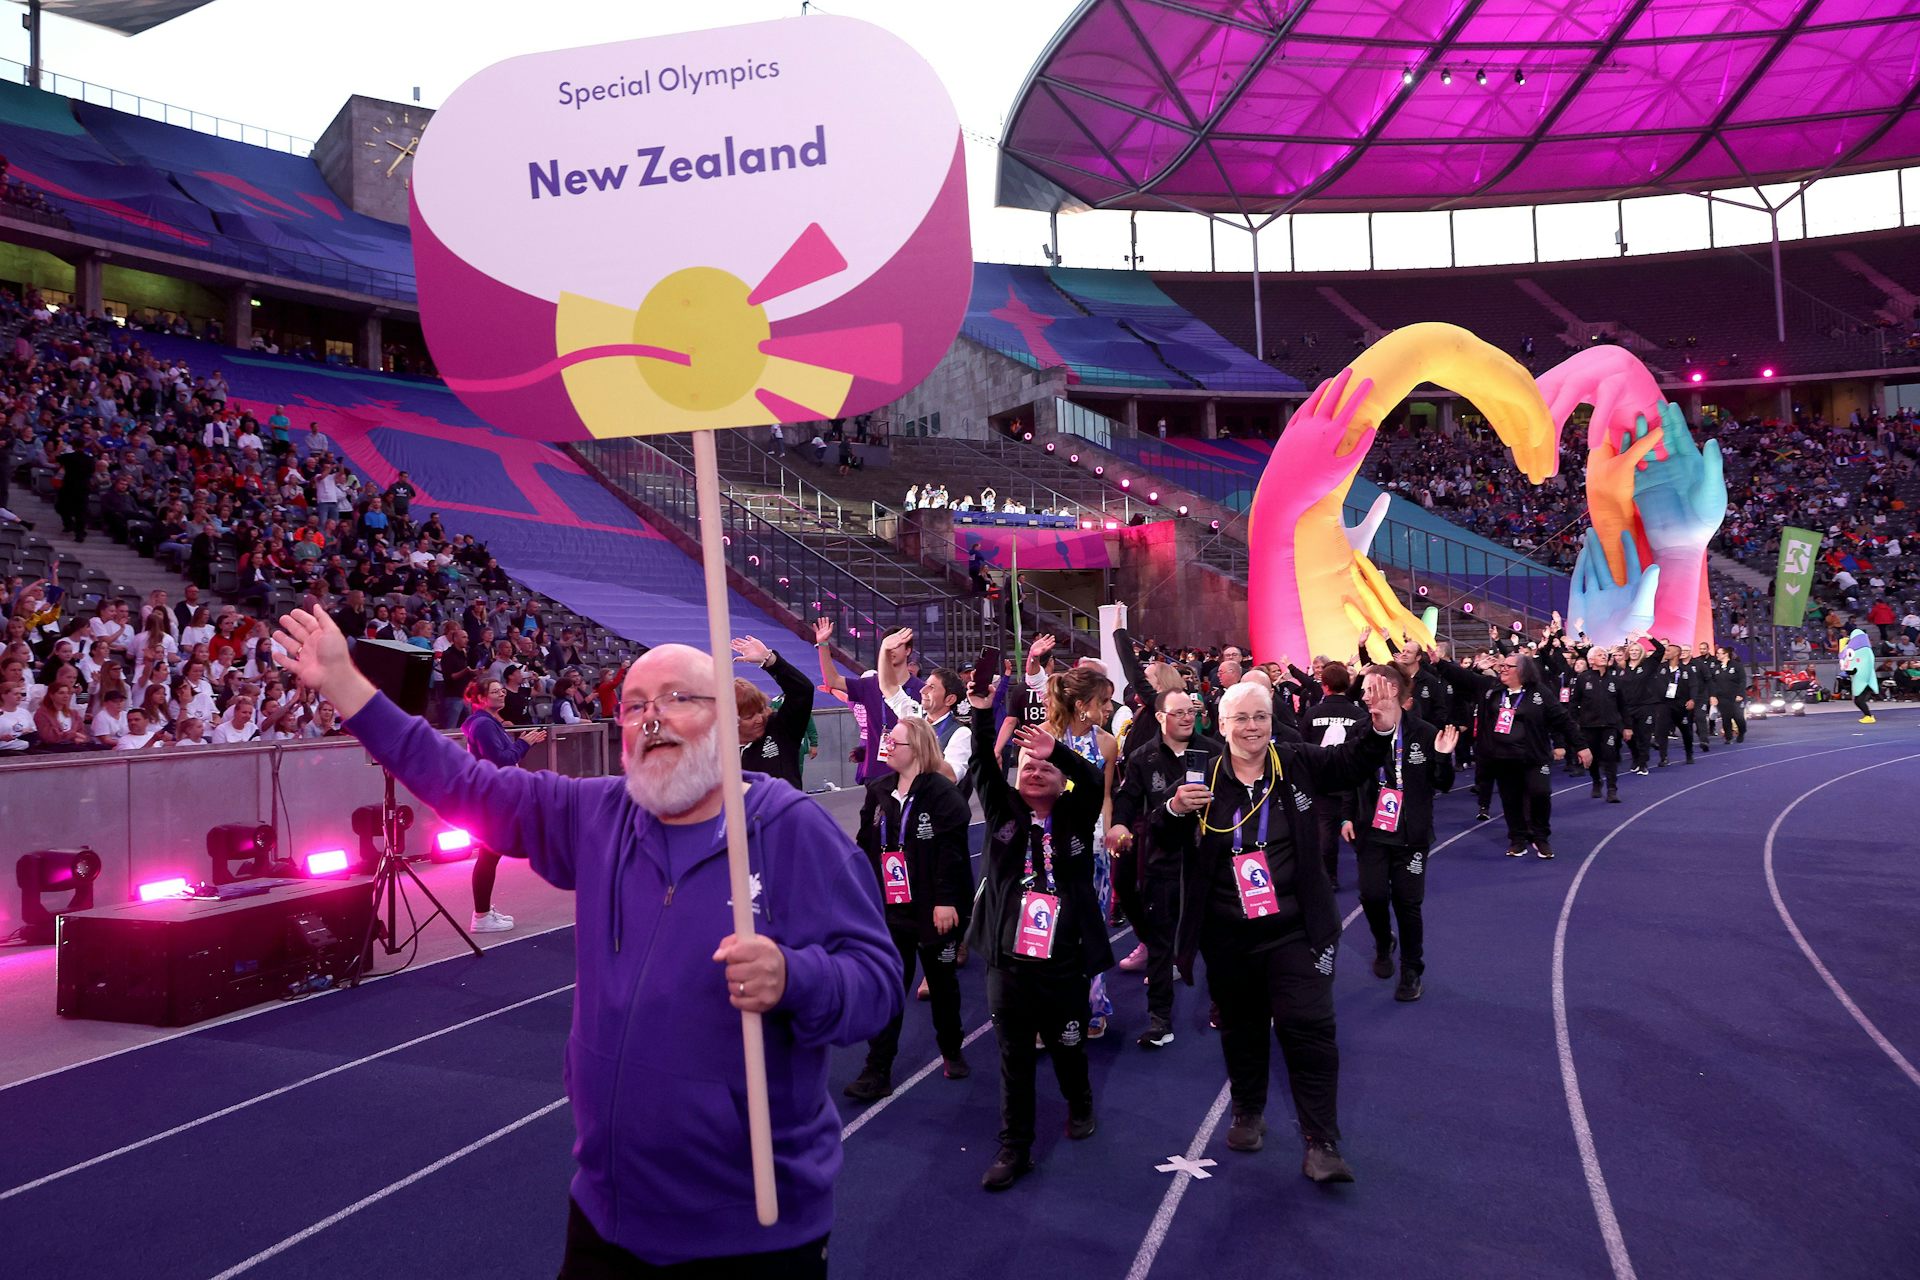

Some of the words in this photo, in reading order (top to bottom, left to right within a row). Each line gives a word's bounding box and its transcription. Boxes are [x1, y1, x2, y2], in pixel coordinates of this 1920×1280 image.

[558, 69, 651, 110] Special
[658, 58, 780, 95] Olympics
[528, 159, 628, 200] New
[637, 124, 827, 187] Zealand
